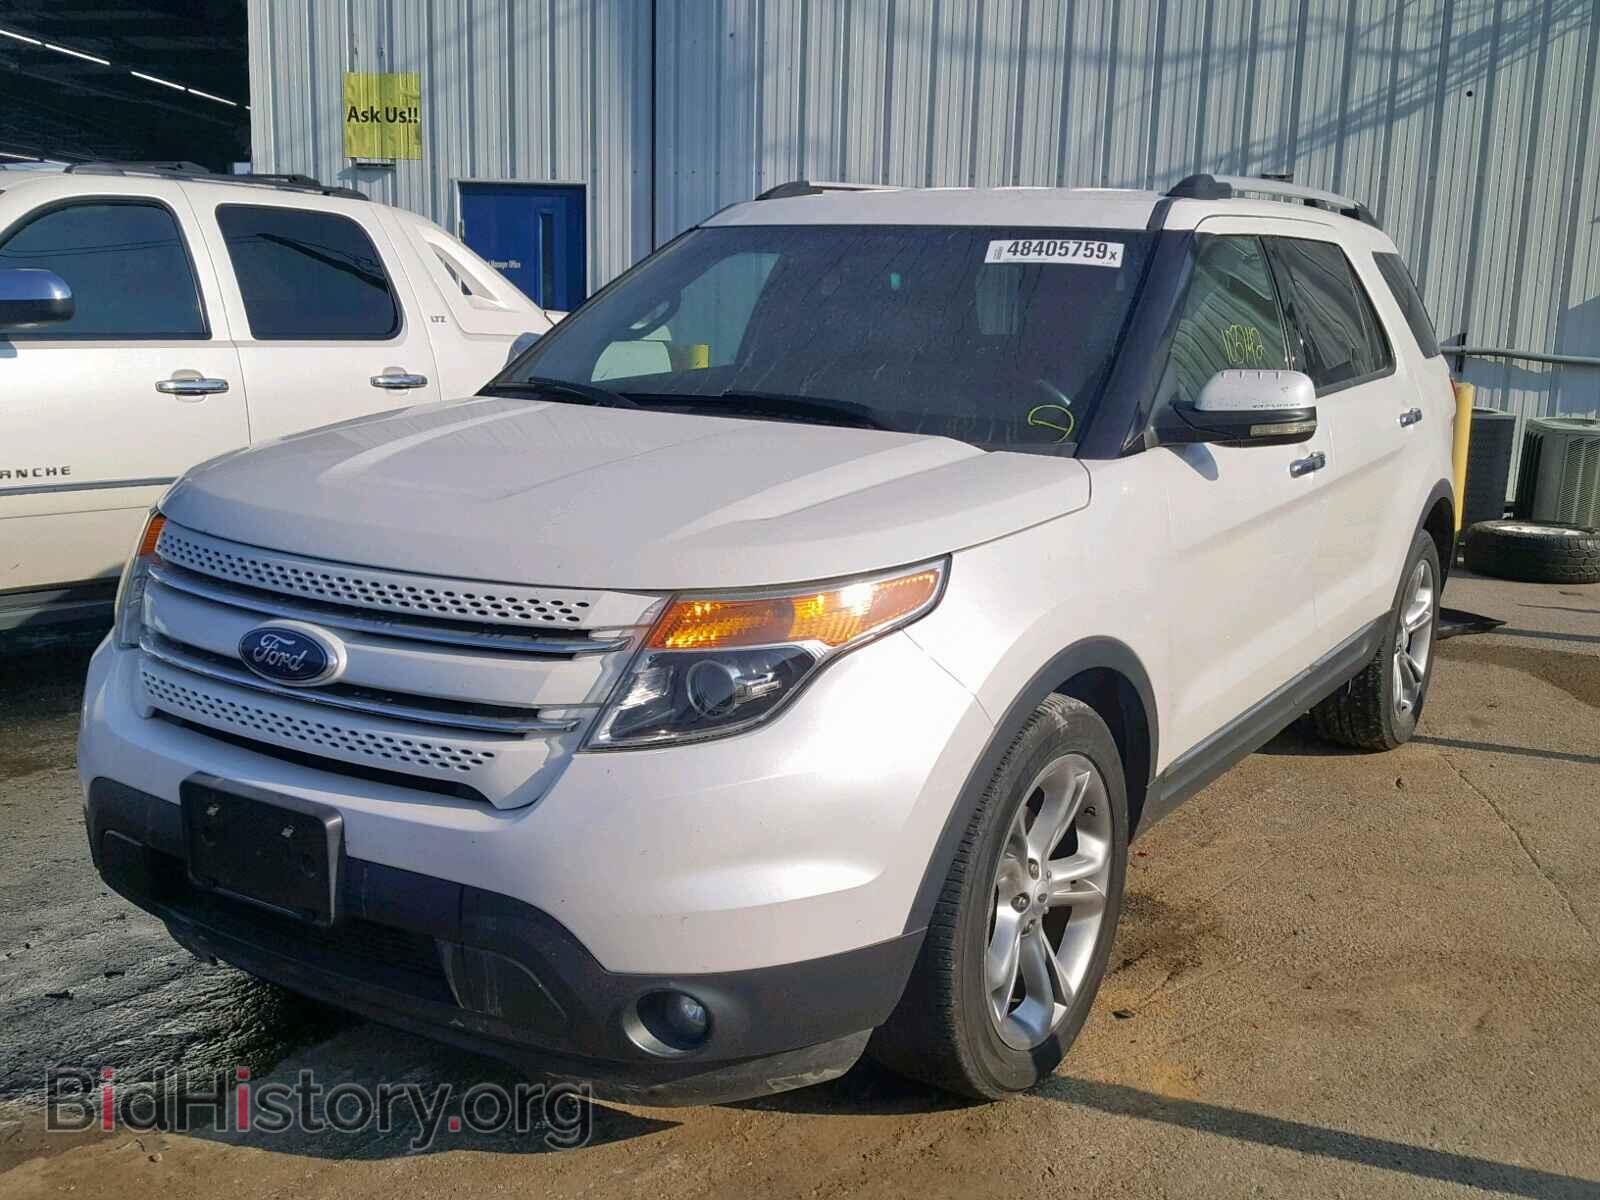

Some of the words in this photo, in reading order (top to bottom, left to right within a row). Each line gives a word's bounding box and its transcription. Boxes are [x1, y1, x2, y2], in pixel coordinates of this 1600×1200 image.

[346, 105, 381, 123] Ask
[385, 106, 418, 124] Us!!
[430, 315, 447, 323] LTZ
[253, 633, 308, 672] Ford
